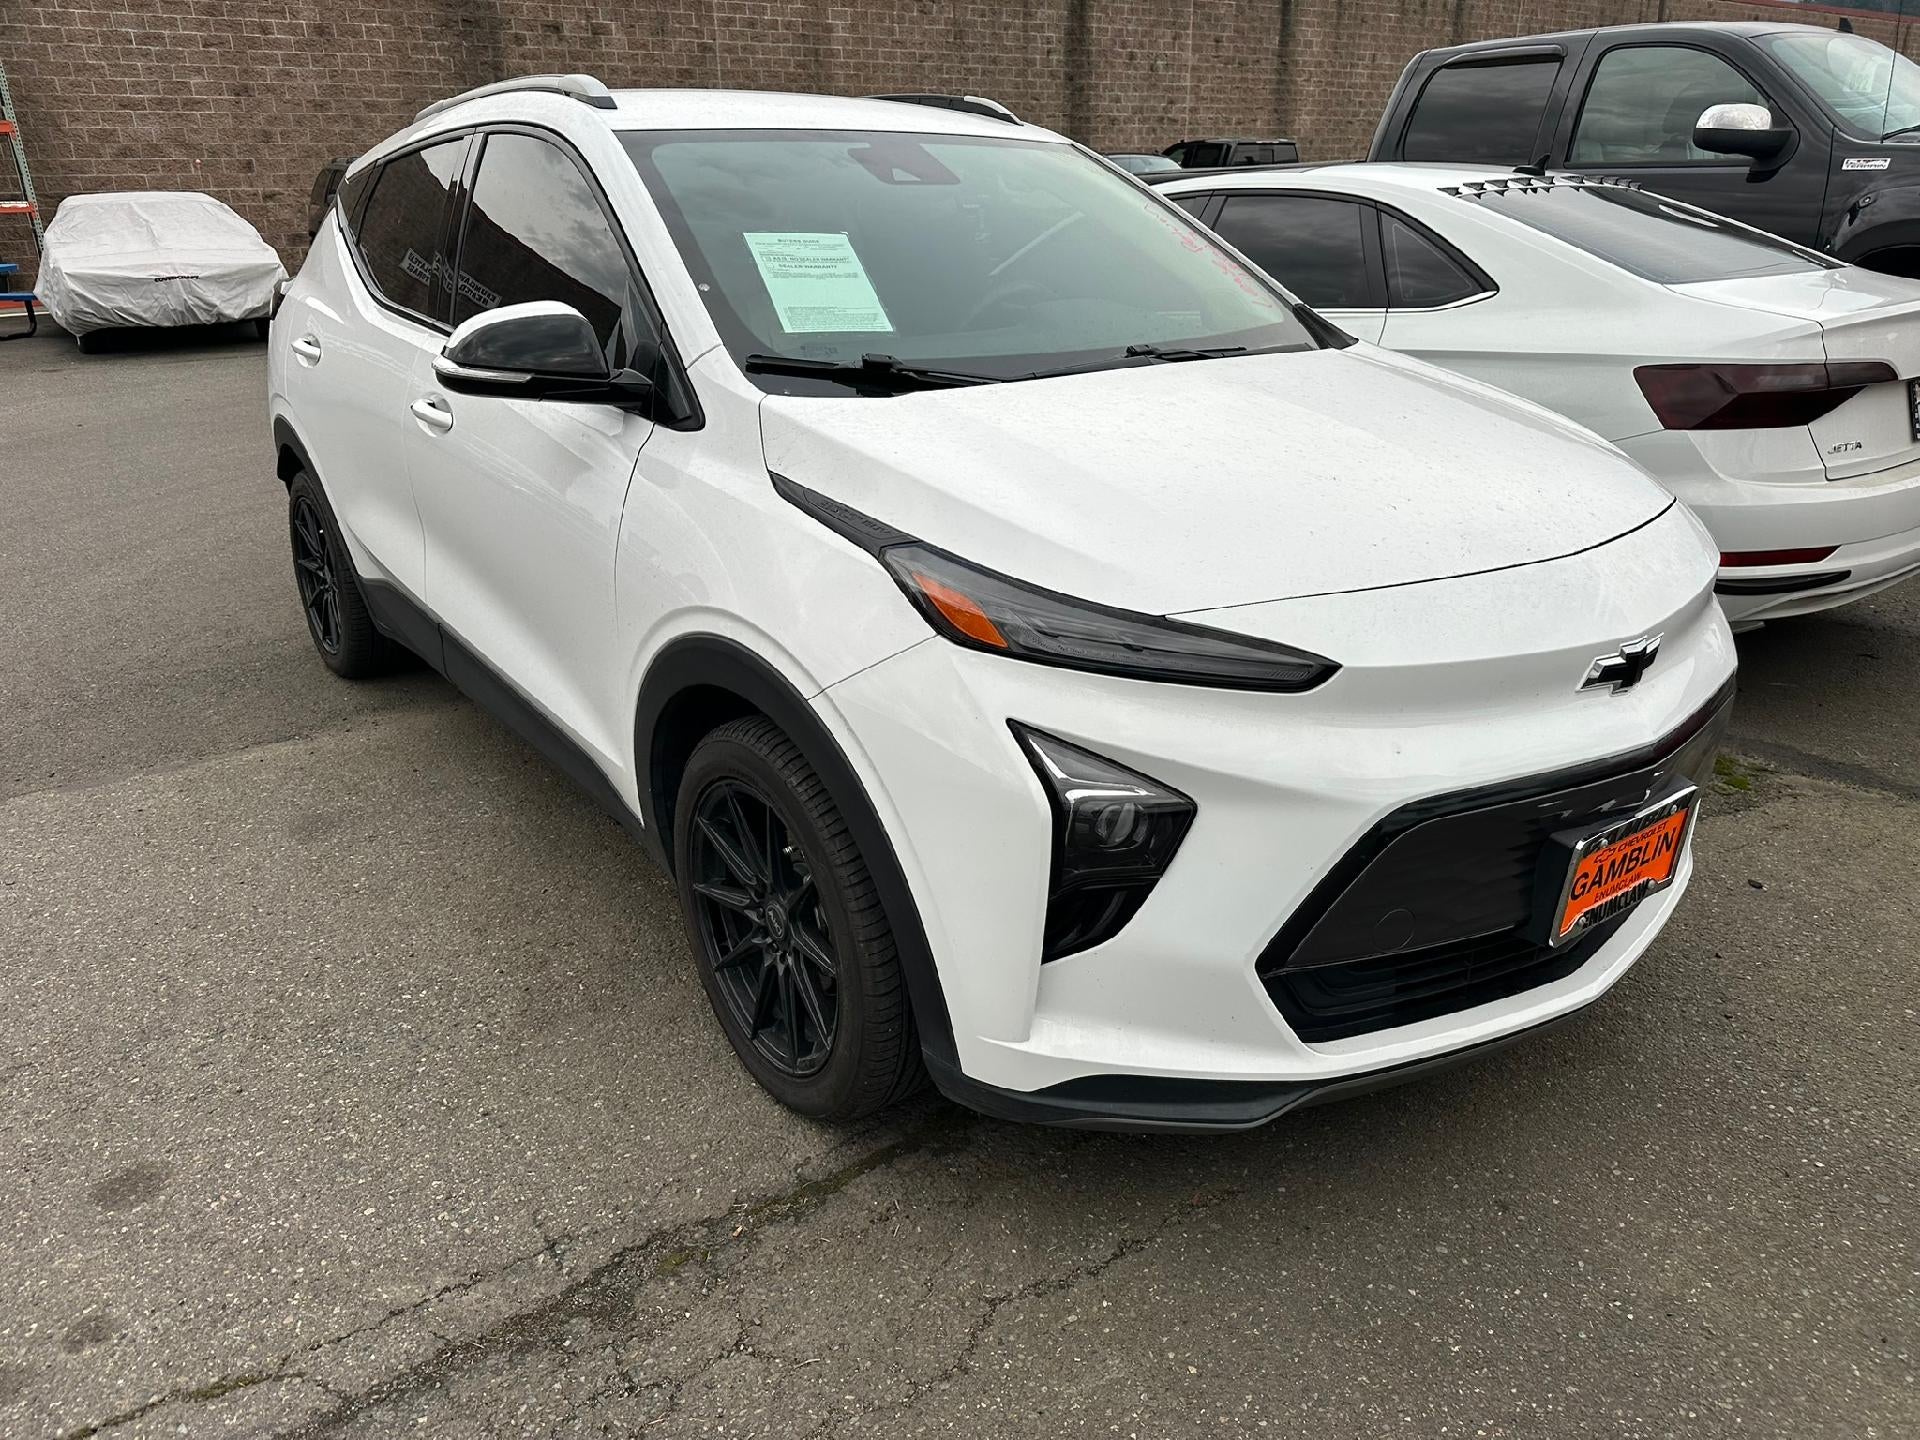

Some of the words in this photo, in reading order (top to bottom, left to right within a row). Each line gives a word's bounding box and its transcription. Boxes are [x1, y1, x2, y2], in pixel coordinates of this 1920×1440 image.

[1827, 441, 1863, 455] JETTA
[1617, 821, 1669, 853] CHEVROLET
[1570, 827, 1677, 901] GAMBLIN
[1594, 870, 1642, 902] ENUMCLAW
[1583, 878, 1650, 929] ENUMCLAW
